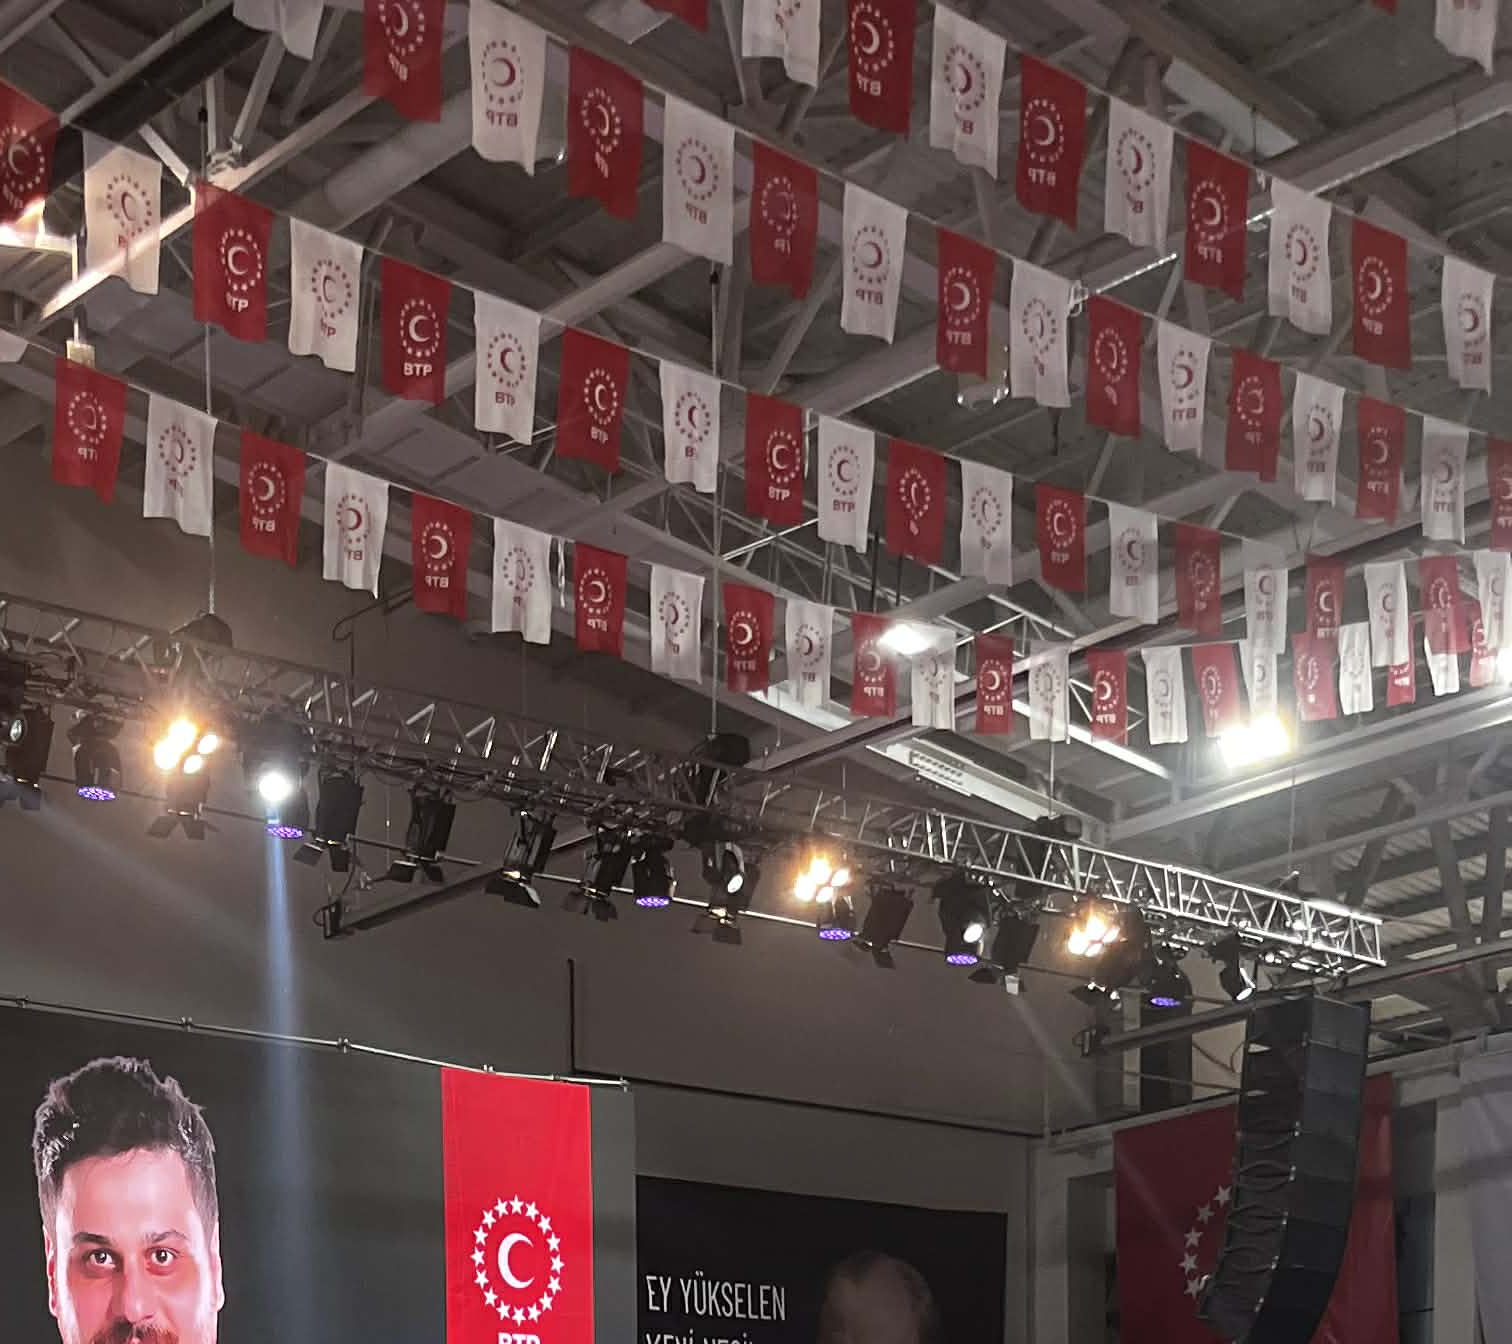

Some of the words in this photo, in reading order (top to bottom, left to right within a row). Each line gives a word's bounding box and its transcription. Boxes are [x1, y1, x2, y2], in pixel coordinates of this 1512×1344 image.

[403, 361, 433, 377] BTP
[769, 485, 790, 501] BTP
[833, 499, 856, 513] BTP
[646, 1275, 672, 1313] EY
[679, 1270, 786, 1321] YÜKSELEN
